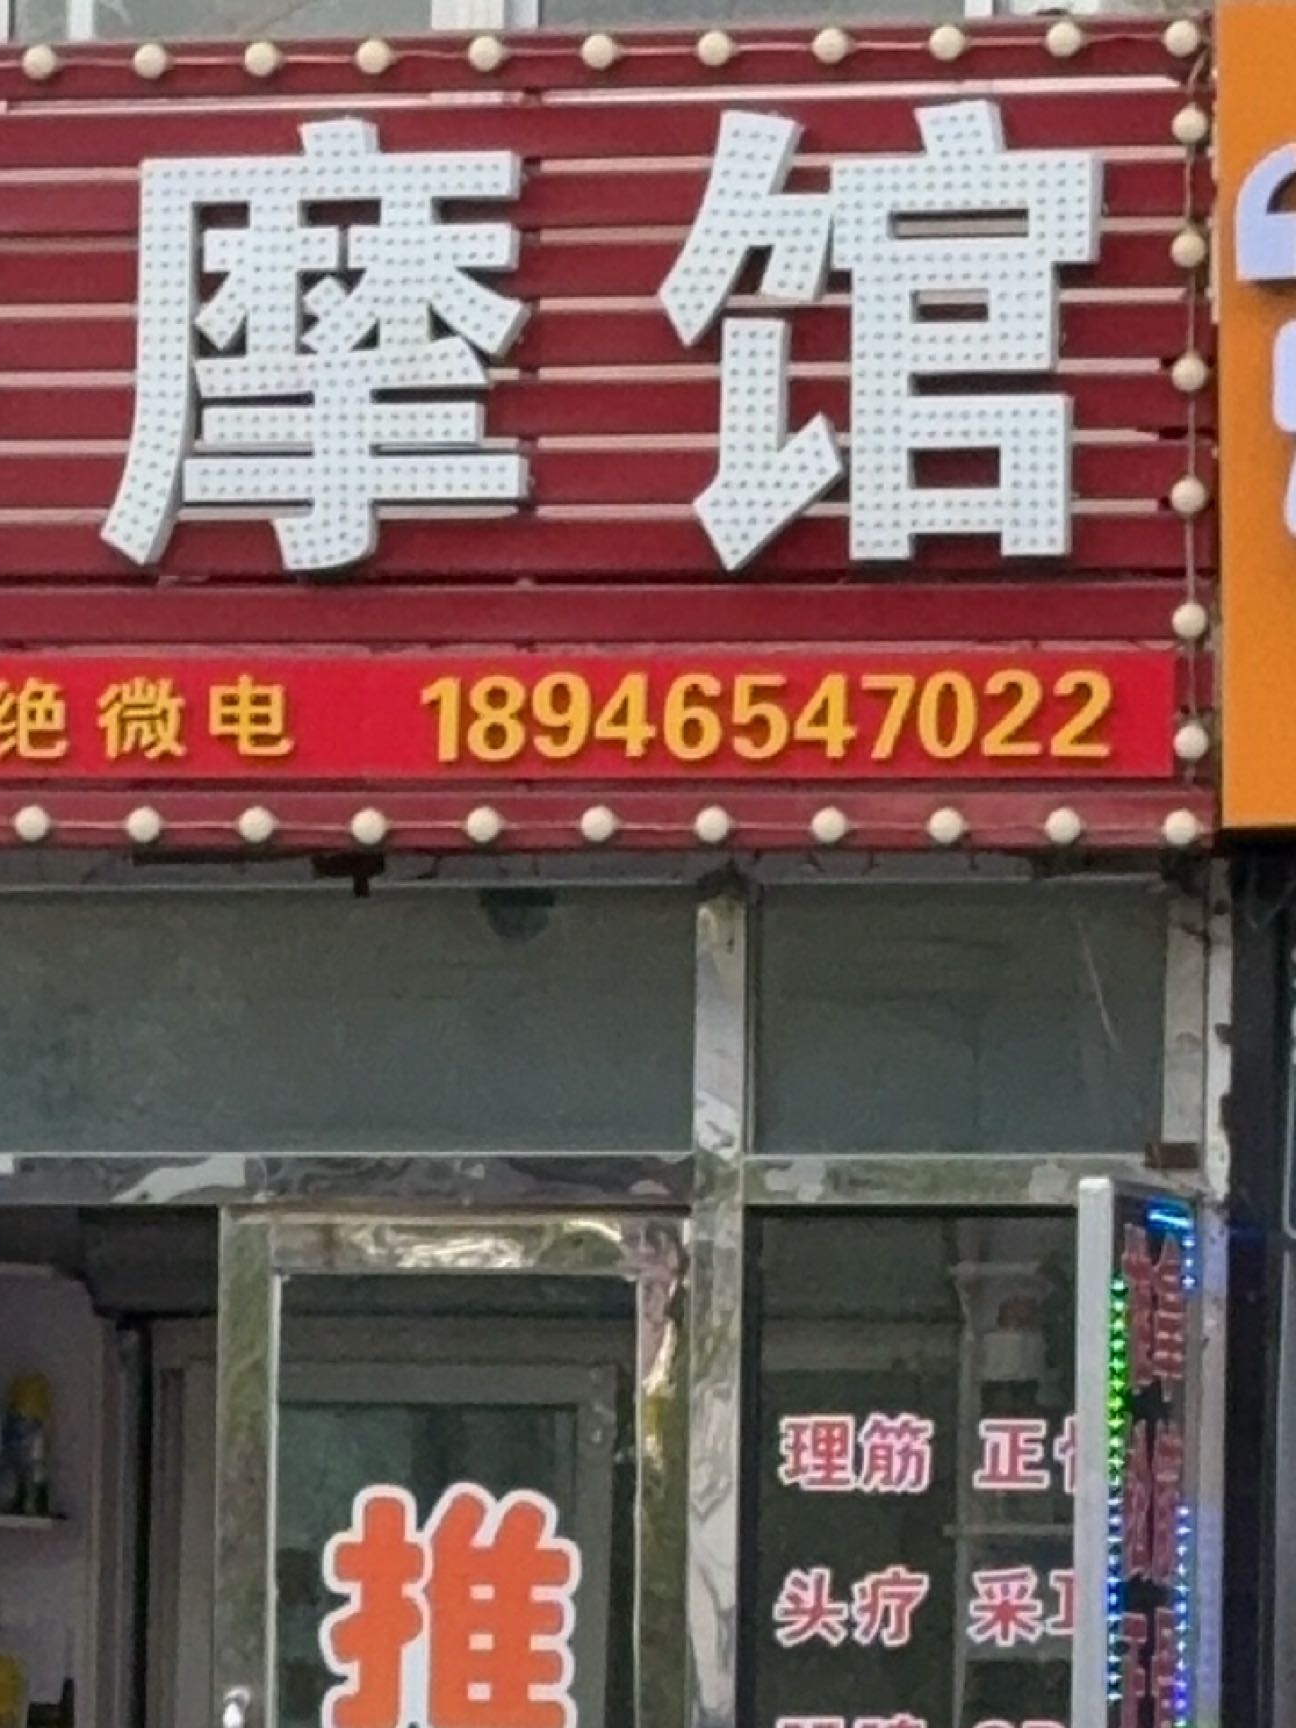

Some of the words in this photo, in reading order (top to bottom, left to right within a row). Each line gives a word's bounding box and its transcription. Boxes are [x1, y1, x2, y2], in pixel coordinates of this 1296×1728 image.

[421, 670, 1113, 763] 18946547022
[779, 1412, 935, 1492] 理筋
[973, 1418, 1076, 1493] 正
[773, 1567, 929, 1650] 头疗
